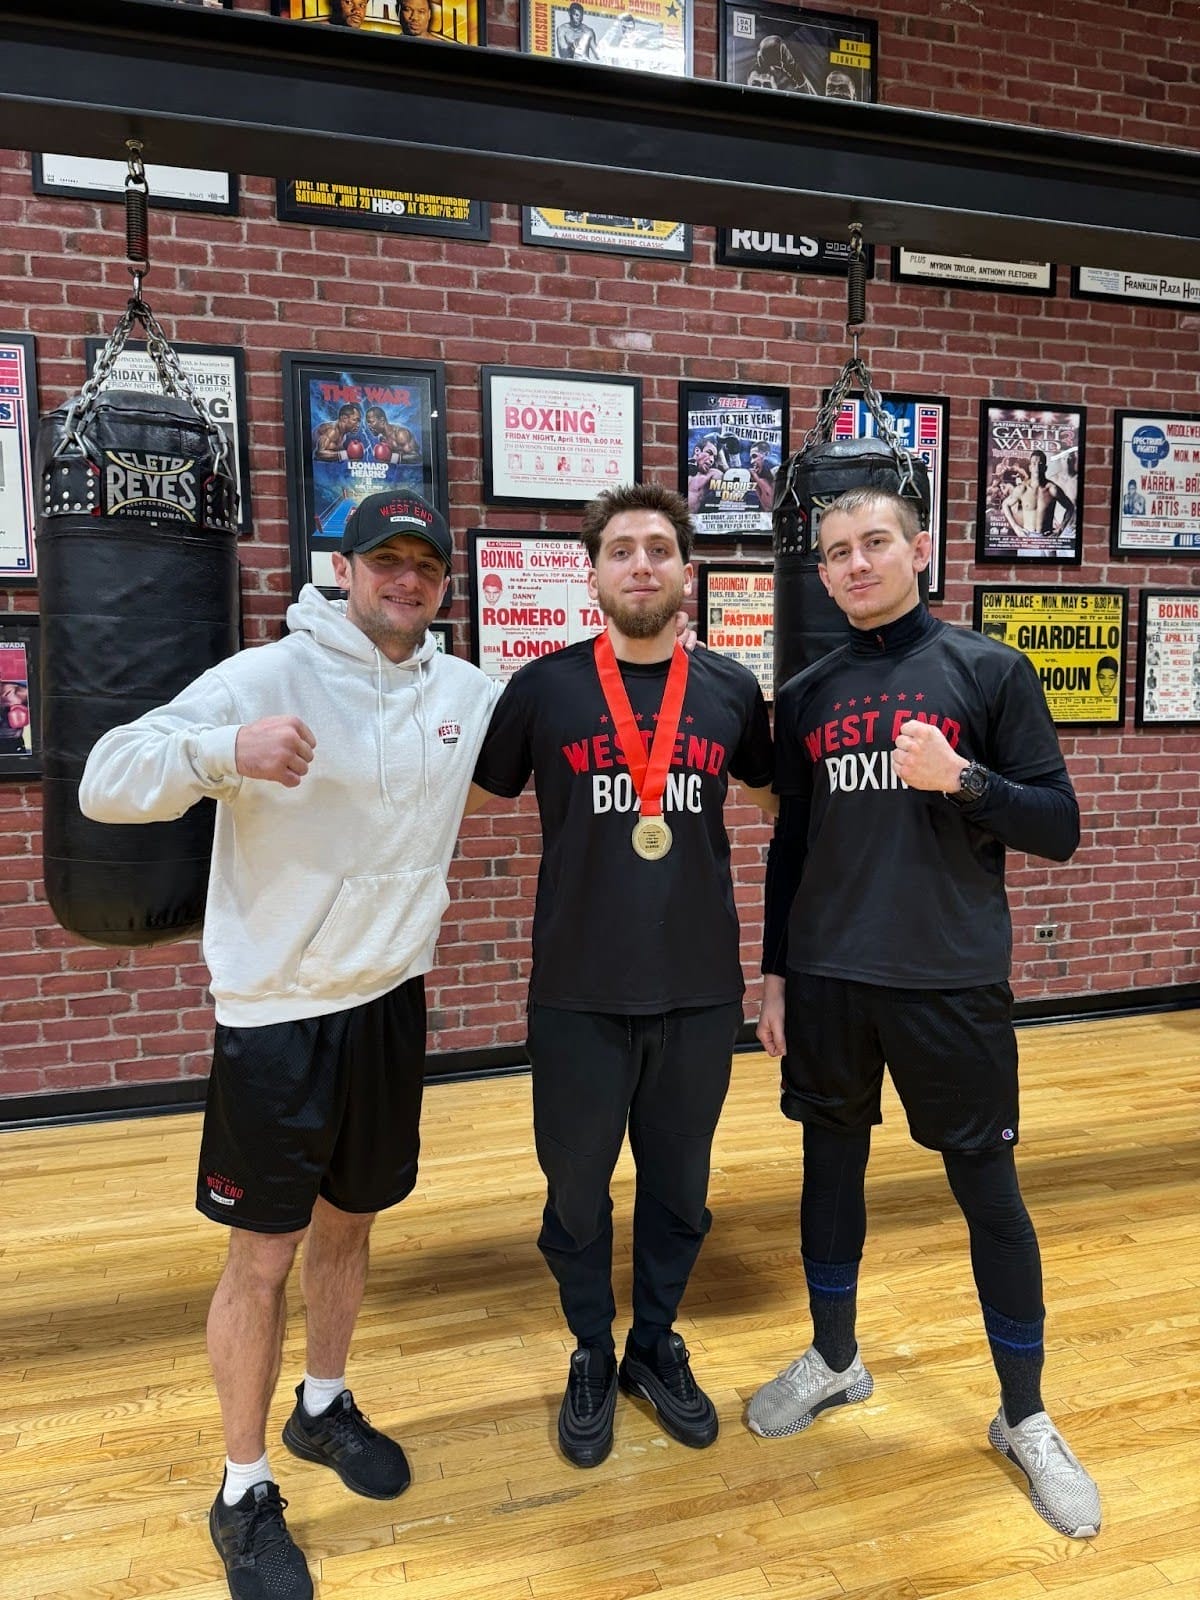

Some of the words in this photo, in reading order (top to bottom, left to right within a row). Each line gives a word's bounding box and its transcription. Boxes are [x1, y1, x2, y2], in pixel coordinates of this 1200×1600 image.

[535, 2, 547, 52] COLISEUM
[295, 190, 338, 208] SATURDAY,
[339, 195, 358, 208] JULY
[359, 197, 370, 209] 20
[372, 198, 406, 215] HBO
[407, 201, 417, 214] AT
[561, 233, 588, 241] MILLION
[591, 235, 616, 244] DOLLAR
[639, 240, 665, 249] CLASSIC
[909, 255, 927, 264] PLUS
[929, 262, 952, 271] MYRON
[978, 267, 1006, 277] ANTHONY
[1007, 270, 1038, 280] FLETCHER
[320, 384, 362, 402] THE
[364, 386, 412, 406] WAR
[720, 398, 748, 408] TECATE
[505, 406, 596, 434] BOXING
[691, 415, 717, 426] FIGHT
[719, 414, 730, 424] OF
[731, 414, 749, 425] THE
[750, 414, 776, 425] YEAR:
[505, 432, 530, 440] FRIDAY
[532, 433, 556, 442] NIGHT,
[557, 436, 574, 444] April
[609, 438, 624, 446] P.M.
[735, 428, 778, 442] REMATCH!
[992, 427, 1060, 441] GATTI
[992, 438, 1062, 452] WARD
[347, 462, 389, 471] LEONARD
[351, 470, 387, 479] HEARNS
[106, 463, 197, 512] REYES
[709, 479, 758, 491] MARQUEZ
[1141, 475, 1175, 492] WARREN
[379, 504, 409, 516] WEST
[414, 507, 433, 523] END
[1151, 500, 1180, 516] ARTIS
[480, 550, 523, 568] BOXING
[530, 555, 580, 568] OLYMPIC
[710, 577, 749, 590] HARRINGAY
[983, 594, 1003, 608] COW
[1004, 595, 1034, 608] PALACE
[1061, 596, 1079, 609] MAY
[1080, 597, 1088, 609] 5
[482, 607, 566, 626] ROMERO
[1159, 604, 1198, 618] BOXING
[710, 634, 762, 647] LONDON
[1018, 625, 1120, 650] GIARDELLO
[1040, 667, 1091, 690] HOUN
[804, 710, 880, 763] WEST
[206, 1175, 223, 1192] WEST
[224, 1184, 244, 1199] END
